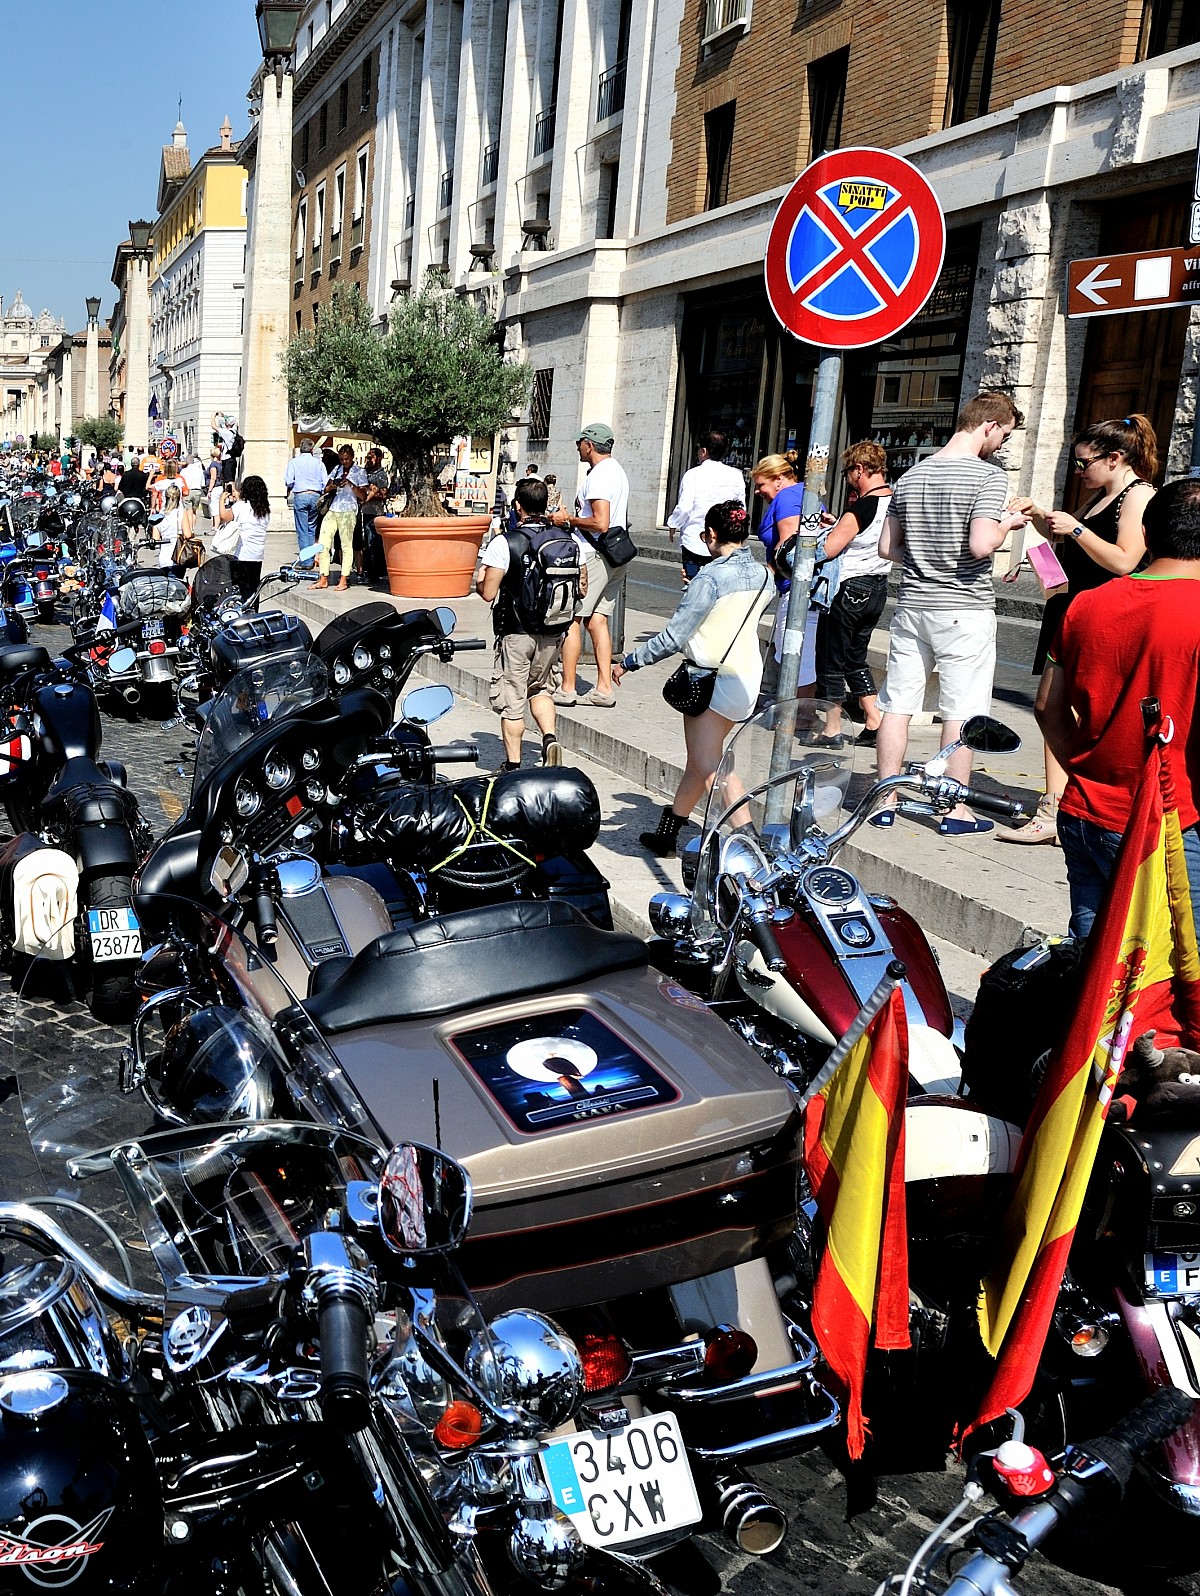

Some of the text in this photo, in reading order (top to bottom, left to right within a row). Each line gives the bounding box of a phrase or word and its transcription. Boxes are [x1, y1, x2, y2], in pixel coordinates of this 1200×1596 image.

[842, 184, 886, 198] SINATTI
[849, 194, 875, 207] POP
[100, 910, 120, 930] DR
[93, 934, 142, 957] 23872
[572, 1103, 628, 1121] RAFA
[1160, 1270, 1171, 1283] E
[573, 1421, 679, 1483] 3406
[560, 1479, 667, 1537] E CXW
